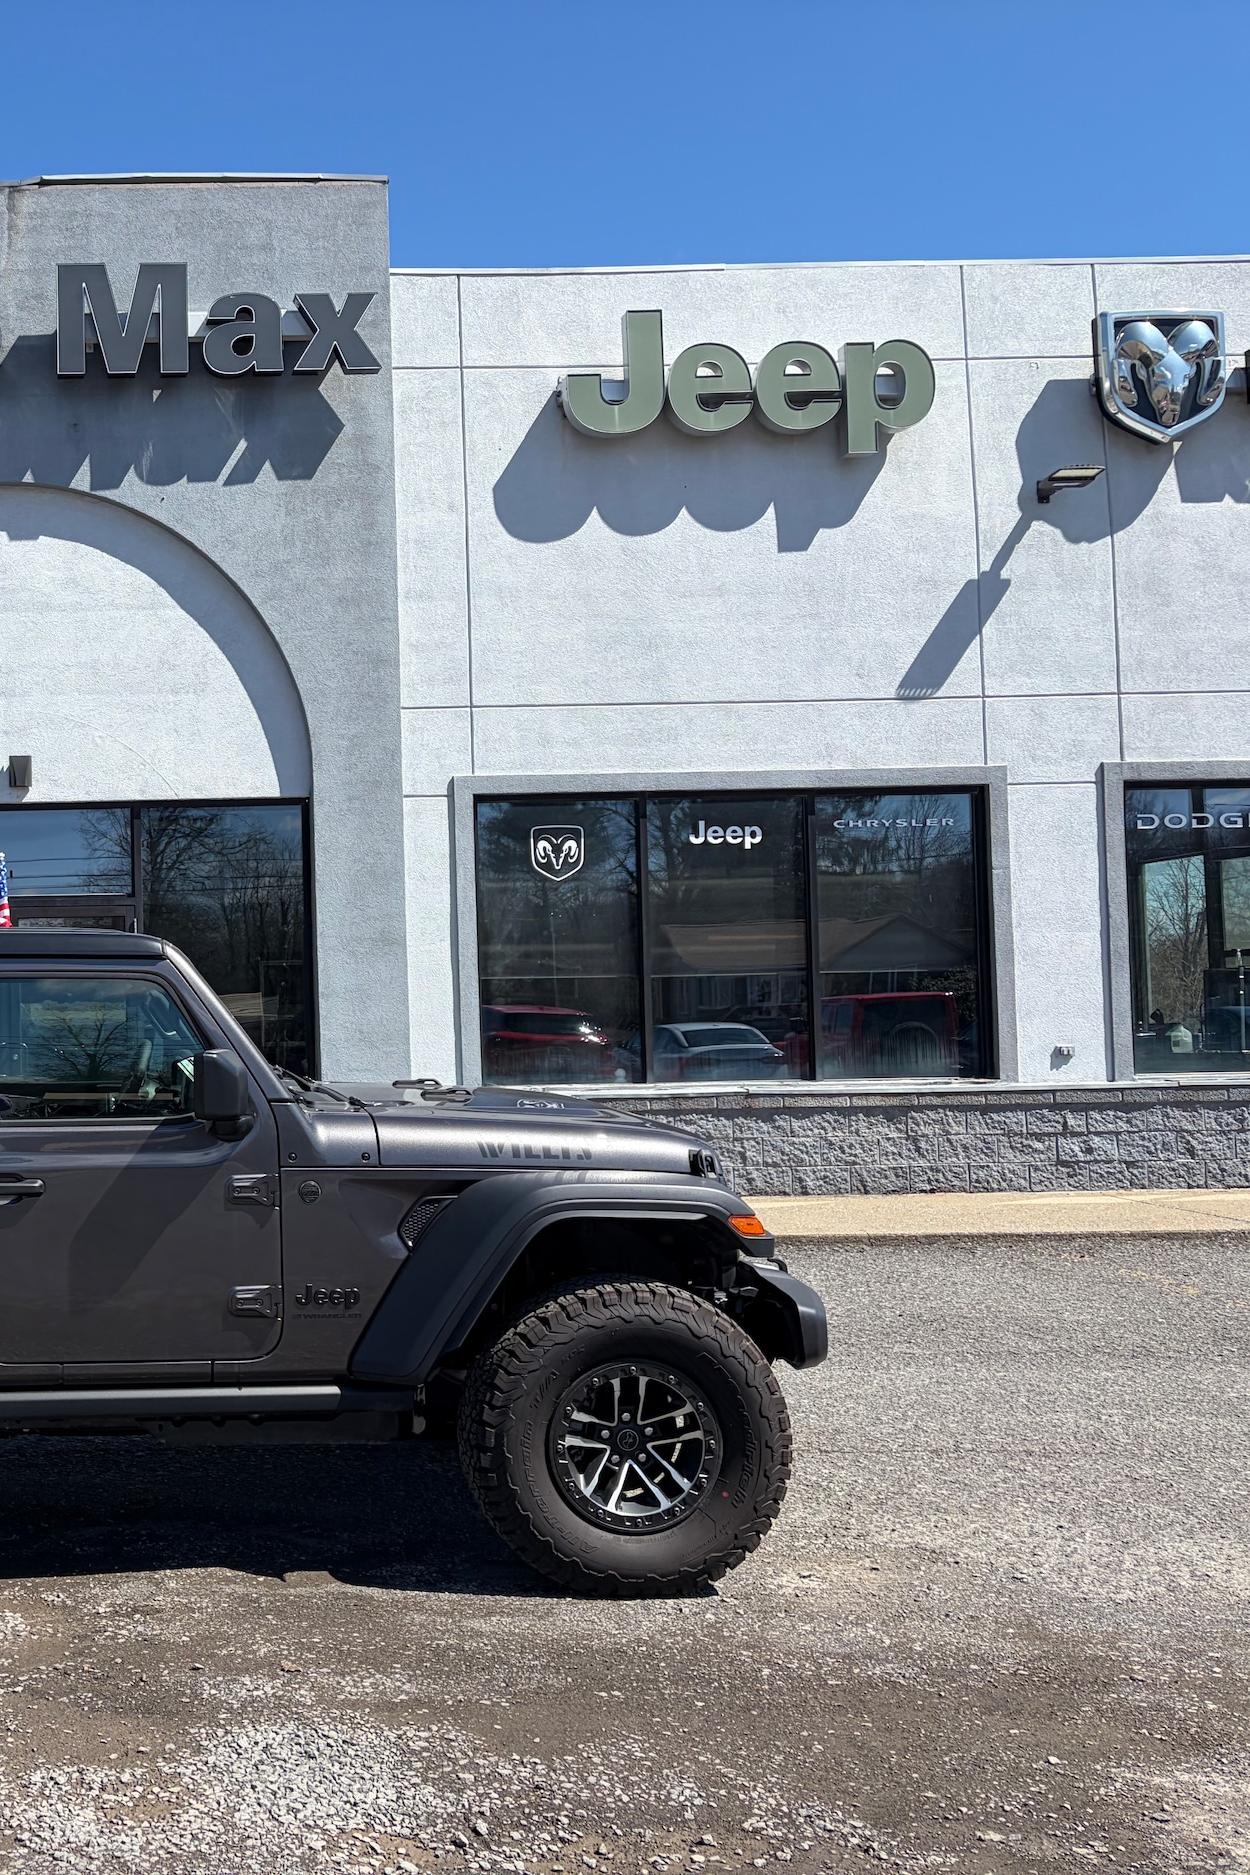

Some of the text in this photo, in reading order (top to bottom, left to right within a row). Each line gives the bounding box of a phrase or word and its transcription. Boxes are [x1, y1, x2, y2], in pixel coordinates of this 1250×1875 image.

[55, 262, 382, 376] Max
[562, 309, 935, 457] Jeep
[689, 820, 763, 849] Jeep
[833, 818, 954, 829] CHRYSLER
[1136, 812, 1250, 830] DODG
[295, 1283, 361, 1309] Jeep
